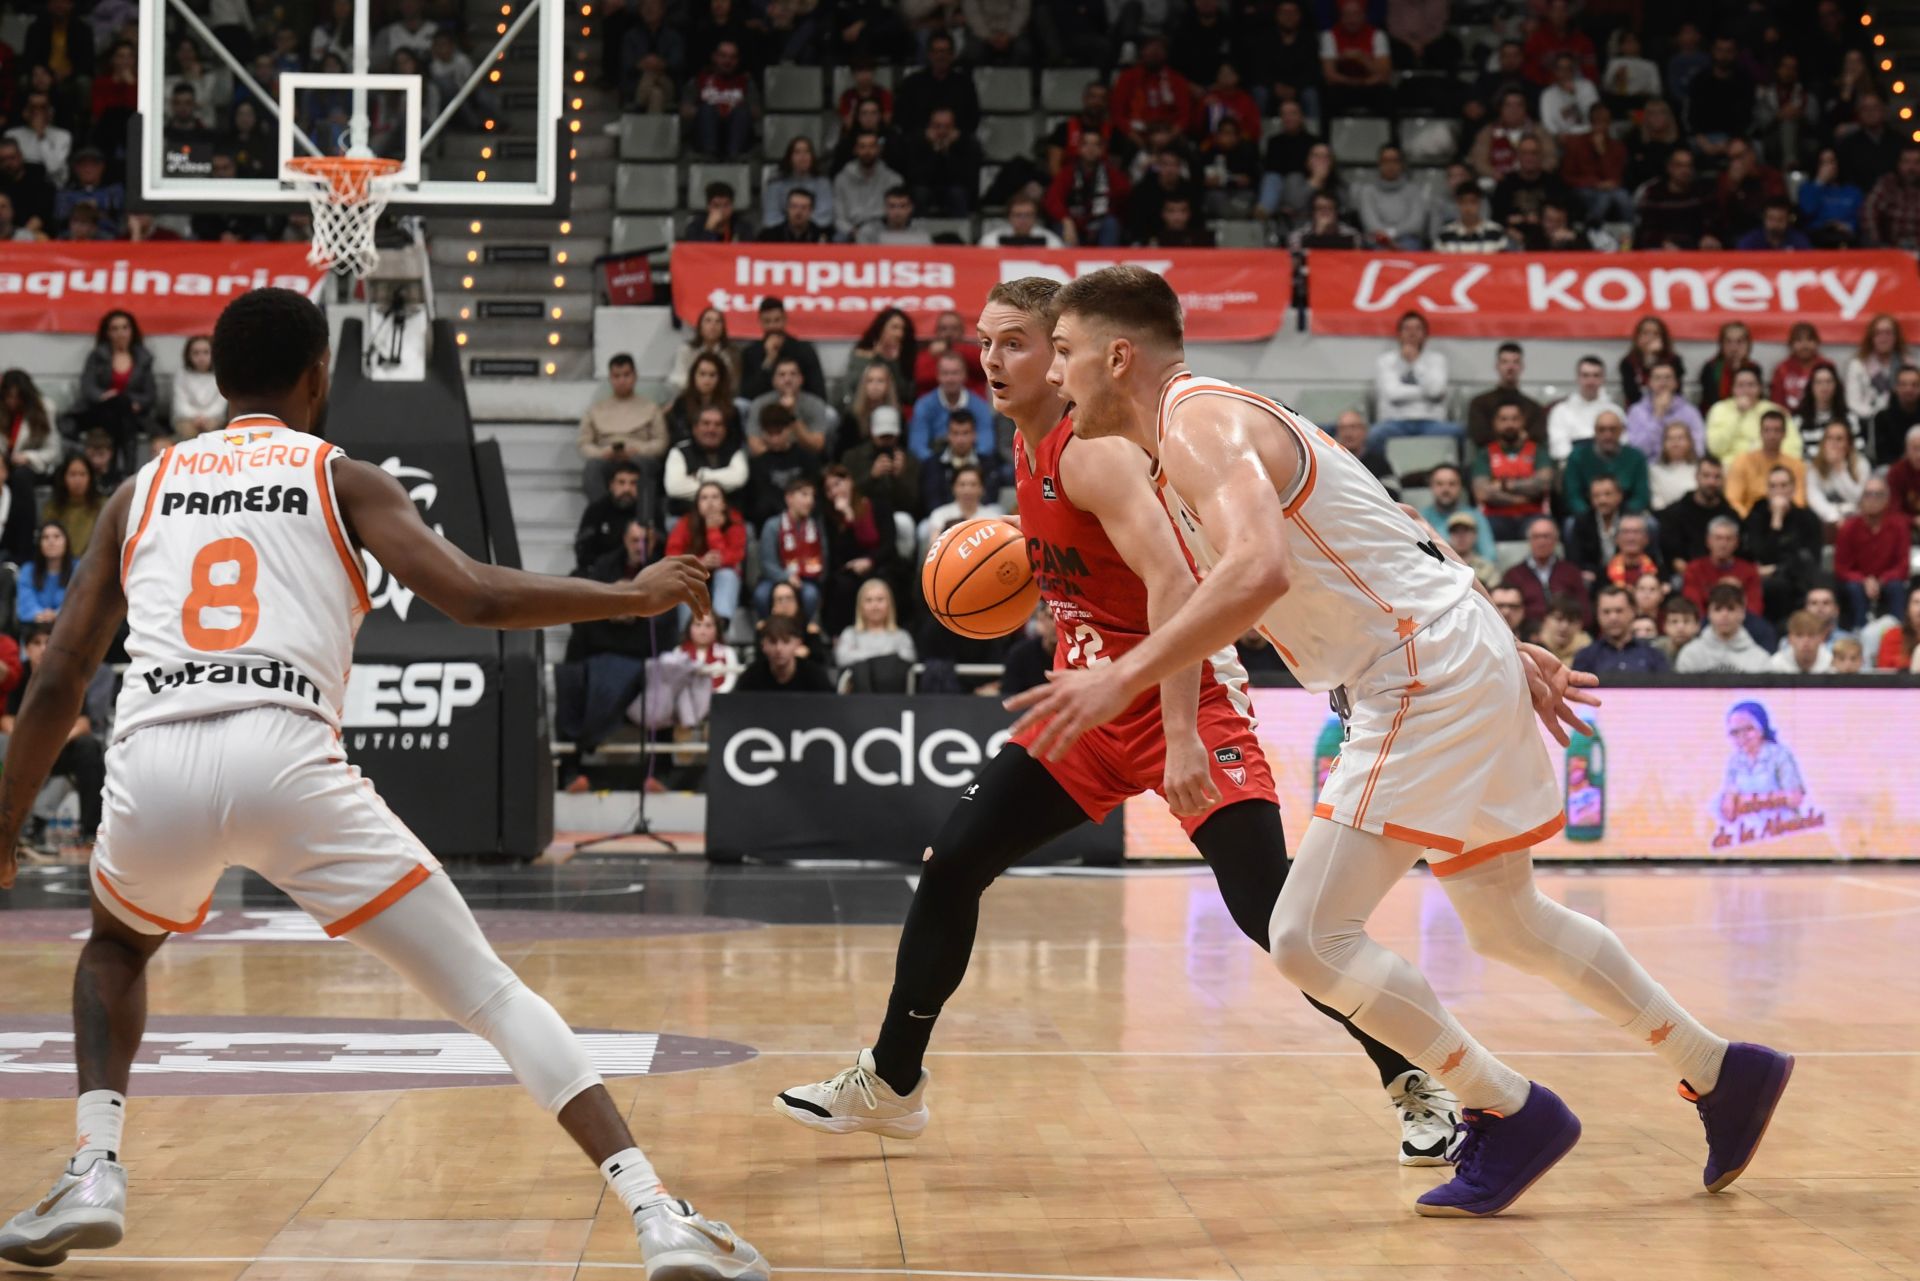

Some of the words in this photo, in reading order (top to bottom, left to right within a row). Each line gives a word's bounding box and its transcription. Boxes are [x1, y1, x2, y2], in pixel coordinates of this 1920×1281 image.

[735, 255, 955, 293] Impulsa
[1526, 263, 1877, 320] konery
[174, 445, 309, 476] MONTERO
[161, 485, 308, 515] PAMESA
[181, 536, 259, 651] 8
[342, 733, 450, 750] UTIONS
[1219, 753, 1237, 761] acb
